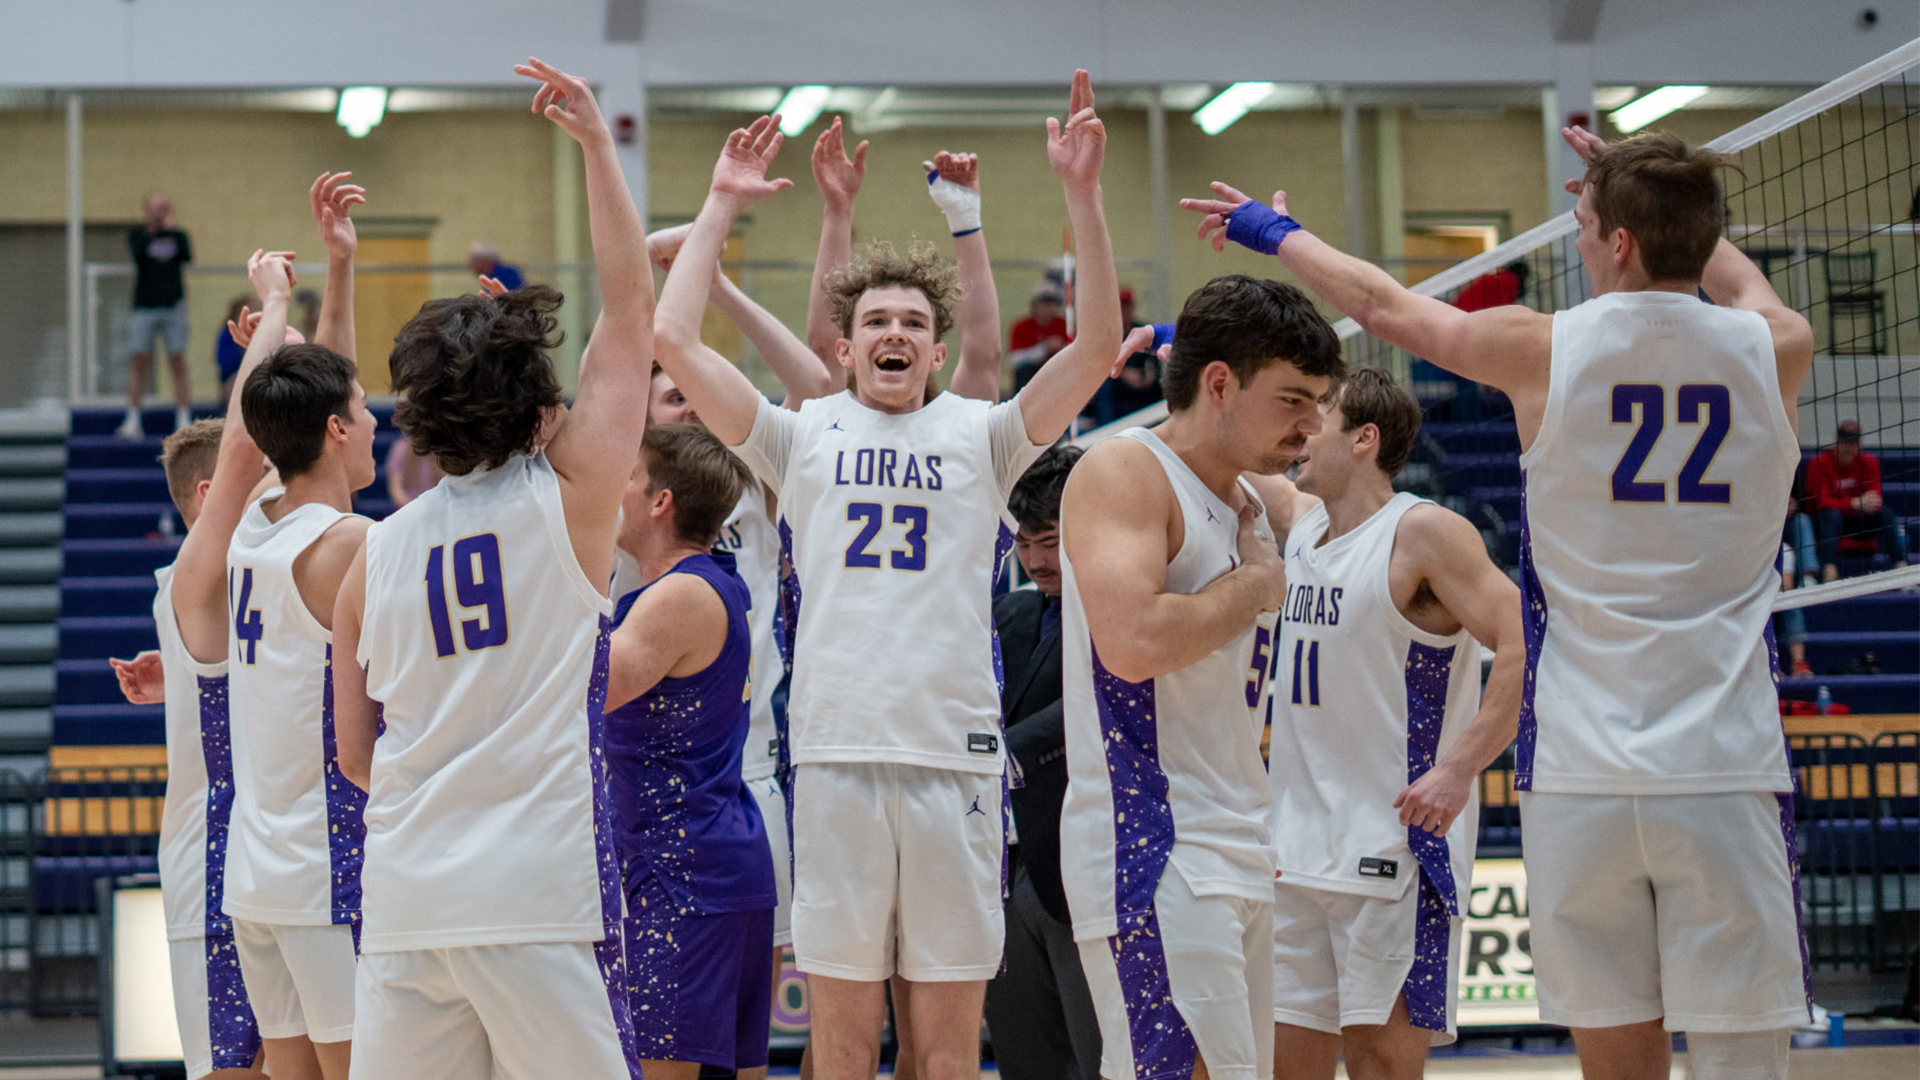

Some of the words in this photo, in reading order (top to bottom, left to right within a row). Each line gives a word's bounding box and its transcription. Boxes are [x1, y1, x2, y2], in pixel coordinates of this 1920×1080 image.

[834, 447, 943, 491] LORAS
[1609, 381, 1734, 506] 22
[843, 499, 930, 573] 23
[229, 565, 265, 667] 4
[422, 530, 511, 660] 19
[1284, 583, 1344, 626] LORAS
[1291, 637, 1322, 708] 11
[1382, 864, 1394, 874] XL
[1467, 886, 1530, 919] CA
